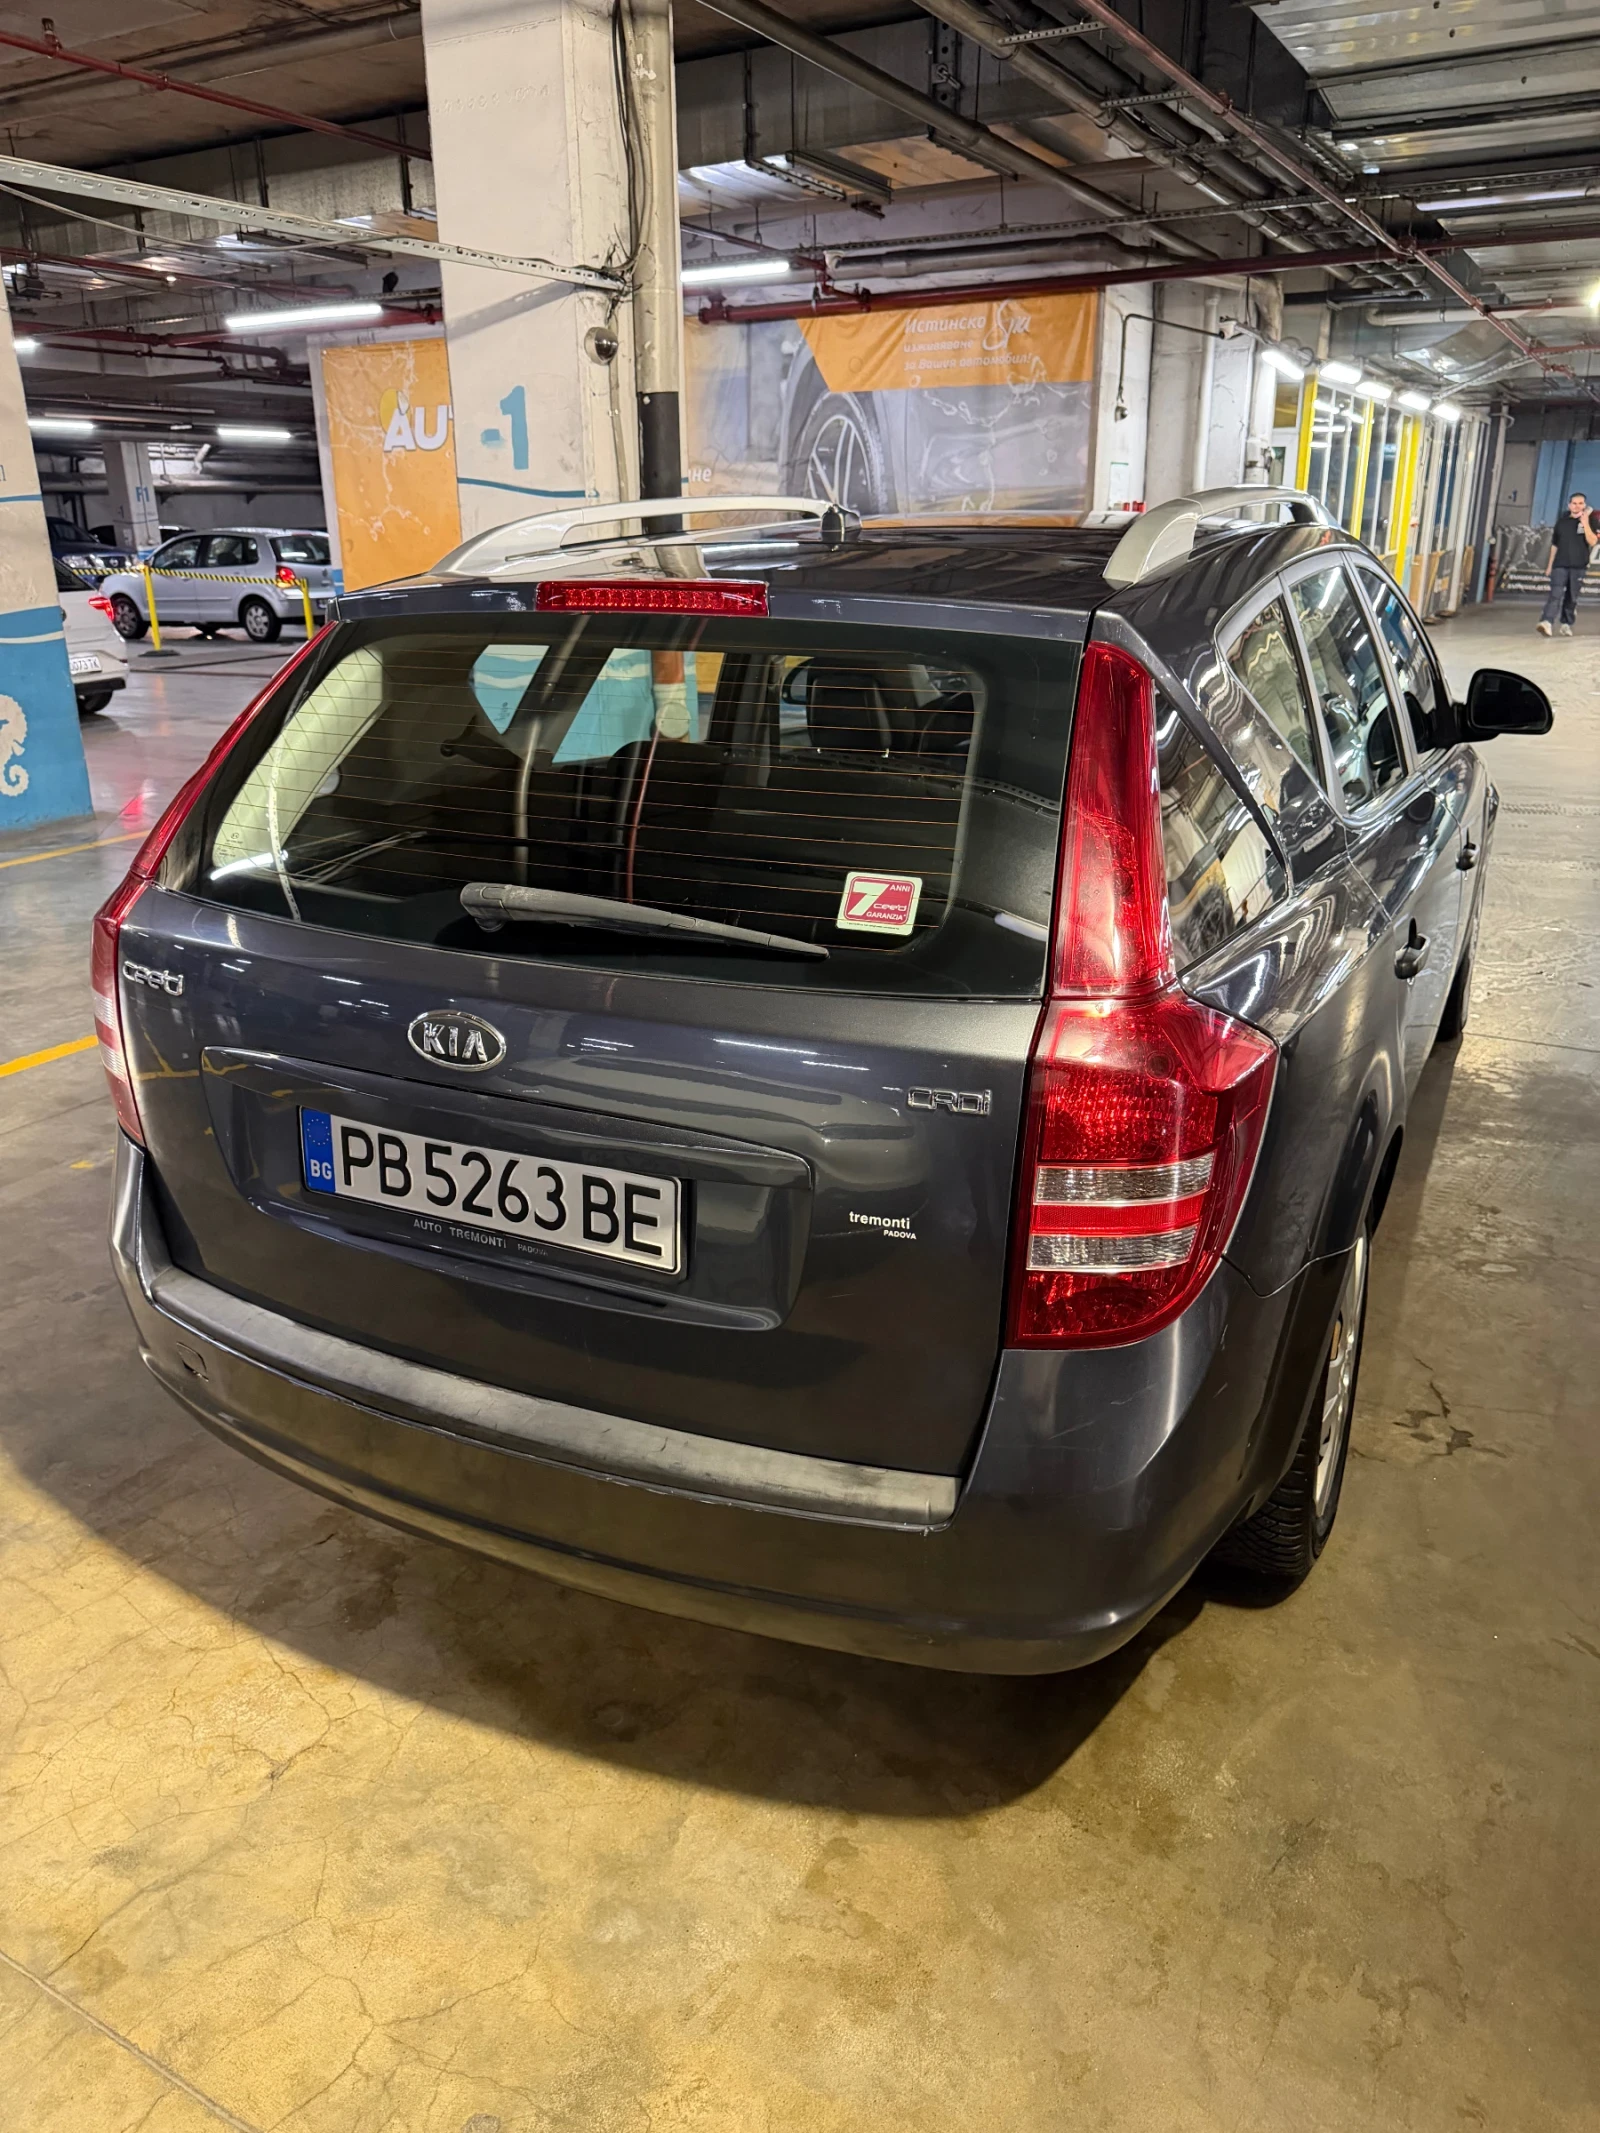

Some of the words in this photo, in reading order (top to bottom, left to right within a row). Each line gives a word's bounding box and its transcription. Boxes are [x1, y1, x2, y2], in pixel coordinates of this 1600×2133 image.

[905, 315, 987, 334] Истинско
[904, 340, 974, 353] изживяване
[918, 357, 957, 370] Вашия
[960, 352, 1033, 367] автомобил!
[384, 404, 454, 451] AU
[480, 385, 529, 470] -1
[847, 881, 890, 916] 7
[889, 884, 911, 892] ANNI
[423, 1021, 488, 1062] KIA
[310, 1158, 332, 1180] BG
[340, 1125, 413, 1198] PB
[424, 1142, 568, 1232] 5263
[582, 1174, 663, 1257] BE
[849, 1211, 911, 1230] tremonti
[413, 1218, 442, 1233] AUTO
[449, 1226, 507, 1249] TREMONTI
[883, 1229, 917, 1240] PADOVA
